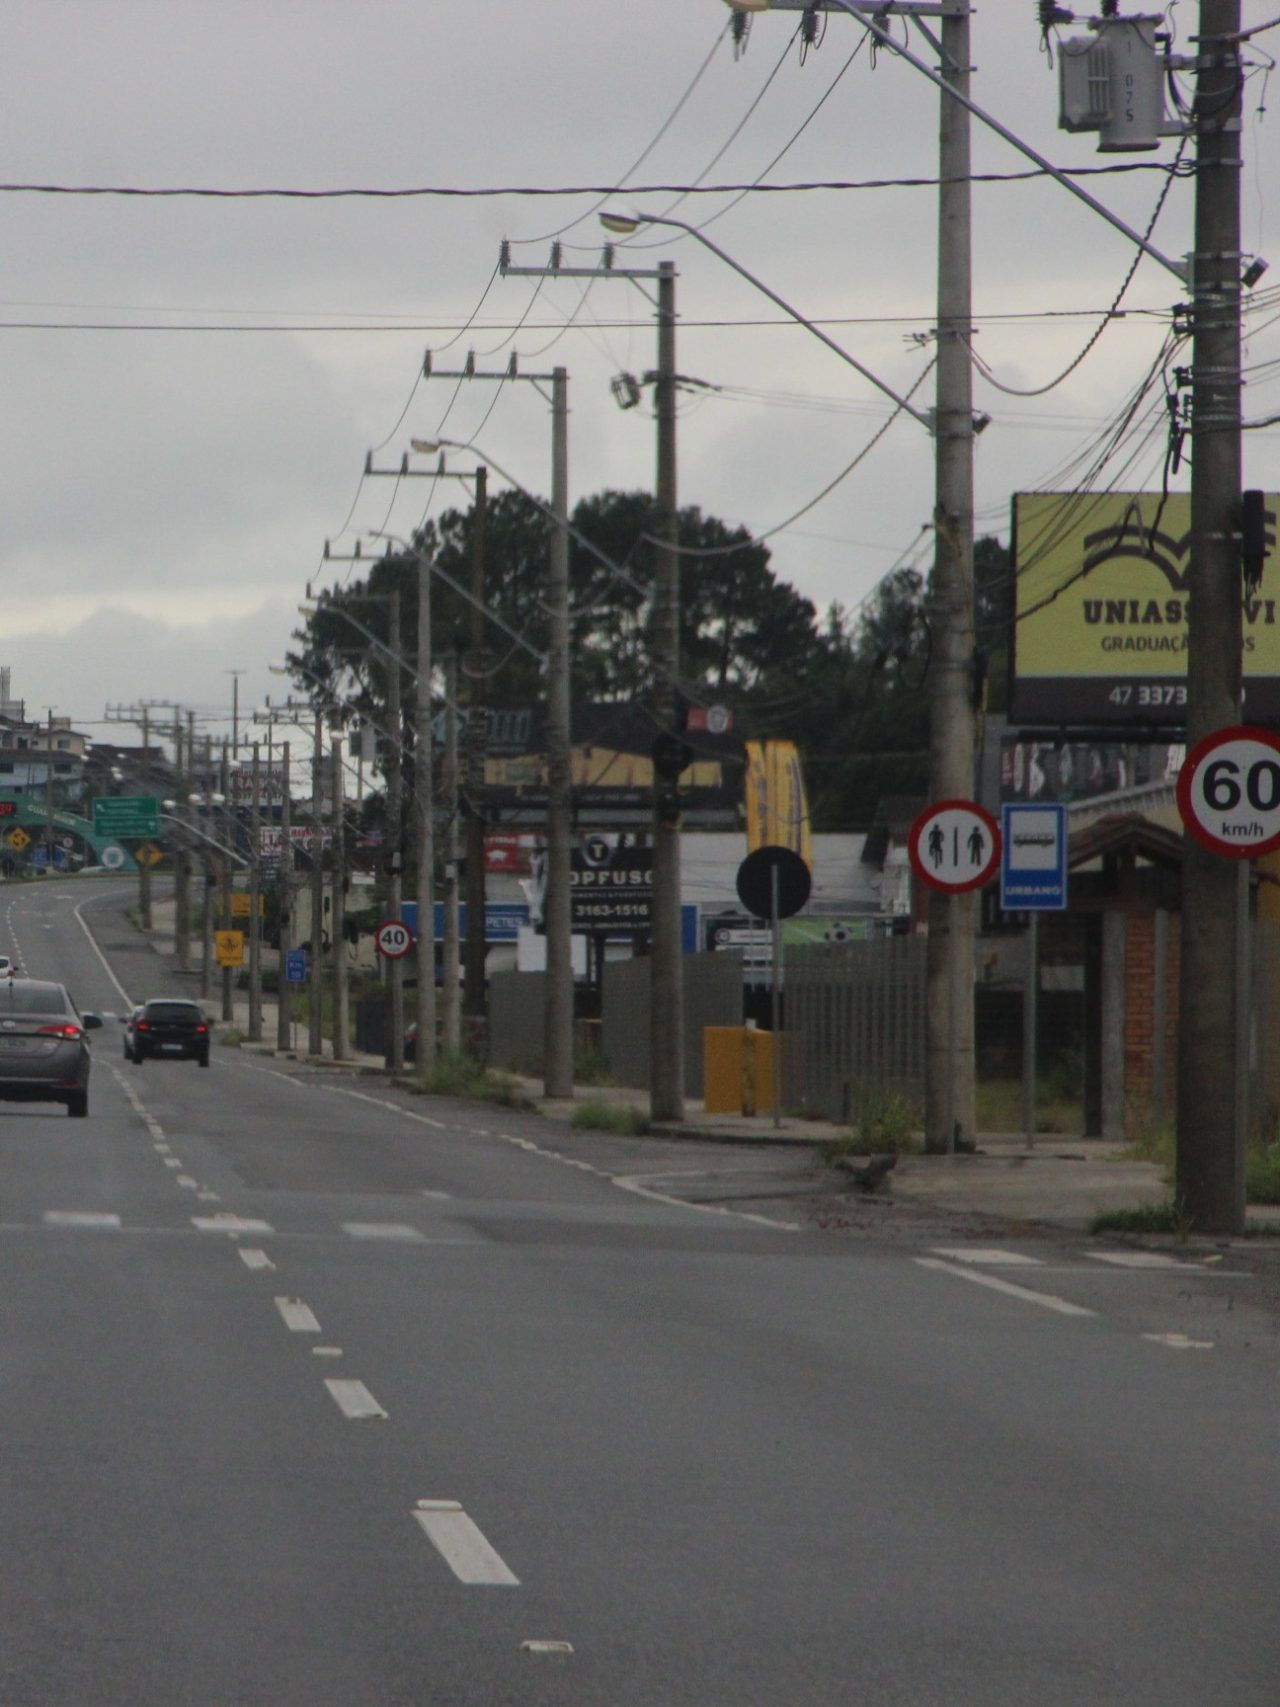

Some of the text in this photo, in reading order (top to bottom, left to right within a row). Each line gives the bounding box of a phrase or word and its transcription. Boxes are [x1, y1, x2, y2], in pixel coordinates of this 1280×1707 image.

[1083, 599, 1276, 624] UNIASVI
[1108, 686, 1132, 705] 47
[1202, 759, 1280, 811] 60
[1222, 821, 1264, 837] km/h
[1005, 886, 1061, 896] URBANO
[381, 930, 405, 945] 40
